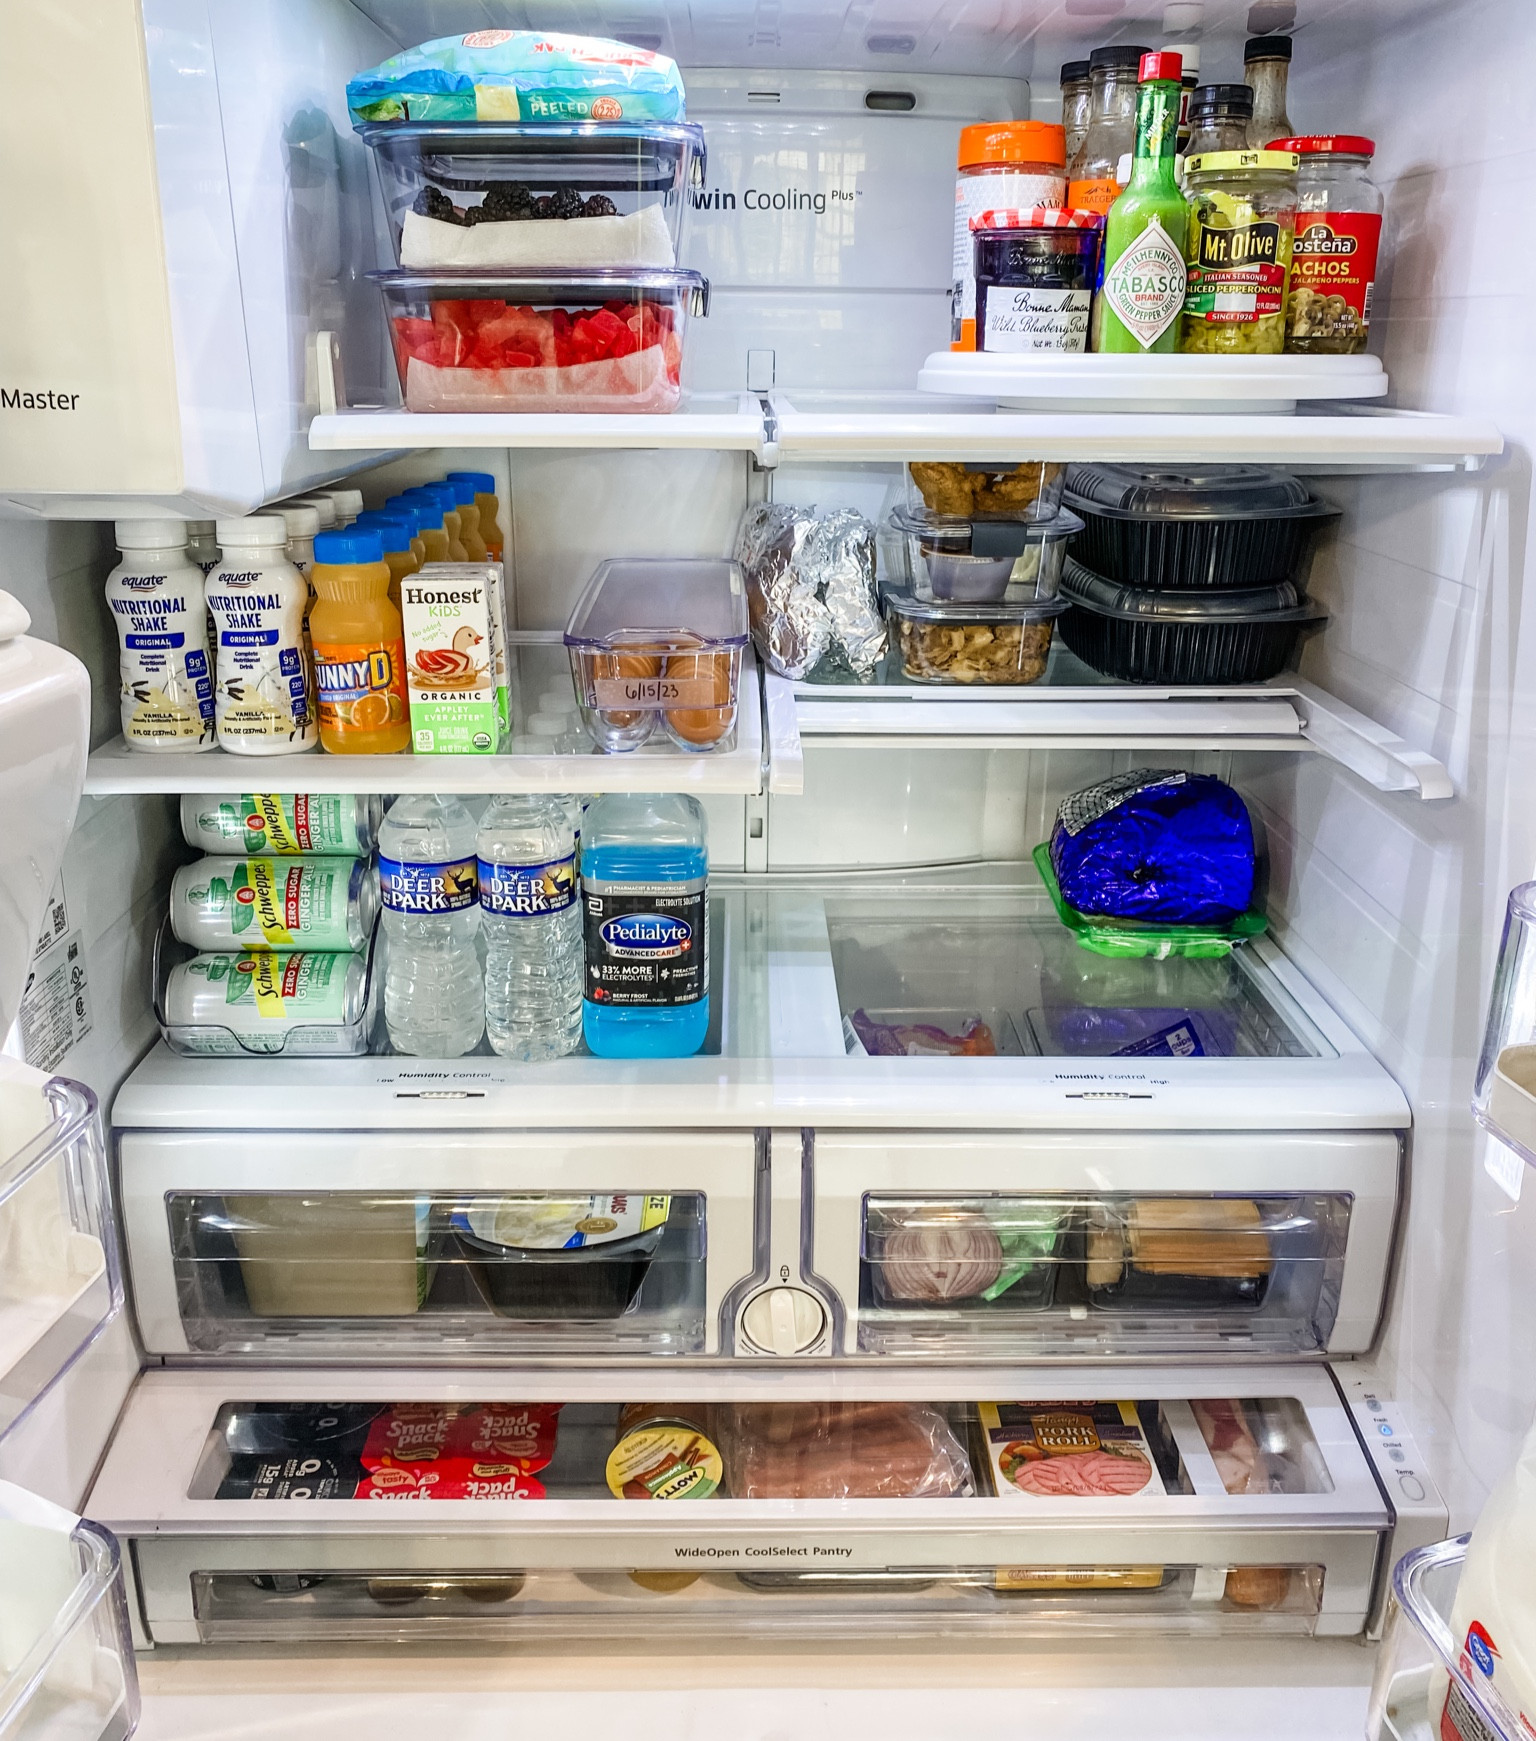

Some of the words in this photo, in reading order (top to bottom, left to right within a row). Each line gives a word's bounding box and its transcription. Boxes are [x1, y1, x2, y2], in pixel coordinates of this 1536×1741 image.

[531, 101, 588, 116] PEELED
[692, 188, 736, 210] win
[744, 188, 826, 214] Cooling
[1311, 228, 1327, 239] La
[1205, 233, 1227, 262] Mt.
[1231, 230, 1273, 262] Olive
[1292, 239, 1351, 253] osteña
[1290, 262, 1350, 276] ACHOS
[1111, 276, 1184, 294] TABASCO
[1205, 273, 1231, 282] ITALIAN
[1232, 273, 1268, 282] SEASONED
[1332, 277, 1360, 285] PEPPERS
[1216, 285, 1281, 294] PEPPERONCINI
[1012, 292, 1052, 313] Bonne
[1054, 293, 1089, 313] Maman
[1135, 294, 1164, 302] BRAND
[1119, 293, 1135, 315] GREEN
[1135, 310, 1161, 320] PEPPER
[1161, 294, 1177, 315] SAUCE
[992, 315, 1016, 333] Wild
[1019, 315, 1070, 339] Blueberry
[1, 388, 80, 411] Master
[122, 575, 167, 588] equate
[218, 571, 262, 586] equate
[208, 594, 281, 611] NUTRITIONAL
[406, 588, 482, 604] Honest
[111, 597, 186, 615] NUTRITIONAL
[131, 617, 167, 632] SHAKE
[226, 613, 262, 628] SHAKE
[412, 630, 422, 638] No
[423, 621, 442, 635] added
[135, 639, 171, 647] ORIGINAL
[230, 635, 265, 643] ORIGINAL
[421, 692, 481, 701] ORGANIC
[626, 681, 678, 701] 6/15/23
[424, 714, 448, 722] EVER
[451, 714, 481, 722] AFTER
[420, 732, 430, 741] 35
[300, 829, 310, 849] ZERO
[310, 812, 324, 852] GINGER
[304, 864, 316, 882] ALE
[288, 868, 300, 898] SUGAR
[391, 874, 447, 893] DEER
[491, 877, 547, 895] DEER
[253, 863, 284, 931] Schweppes
[392, 891, 447, 912] PARK
[491, 894, 547, 914] PARK
[655, 898, 683, 907] ELECTROLYTE
[683, 895, 701, 906] SOLUTION
[287, 901, 298, 927] ZERO
[301, 885, 312, 932] GINGER
[608, 923, 687, 943] Pedialyte
[615, 948, 676, 957] ADVANCEDCARE
[602, 965, 620, 974] 33%
[622, 965, 652, 974] MORE
[285, 970, 296, 994] ZERO
[483, 1412, 529, 1427] pack
[387, 1420, 449, 1438] Snack
[480, 1423, 541, 1439] Snack
[1037, 1427, 1095, 1436] PORK
[399, 1434, 446, 1447] pack
[1042, 1436, 1097, 1446] ROLL
[382, 1473, 409, 1484] tasty
[466, 1477, 516, 1496] pack
[675, 1547, 740, 1558] WideOpen
[745, 1546, 808, 1556] CoolSelect
[813, 1546, 853, 1557] Pantry
